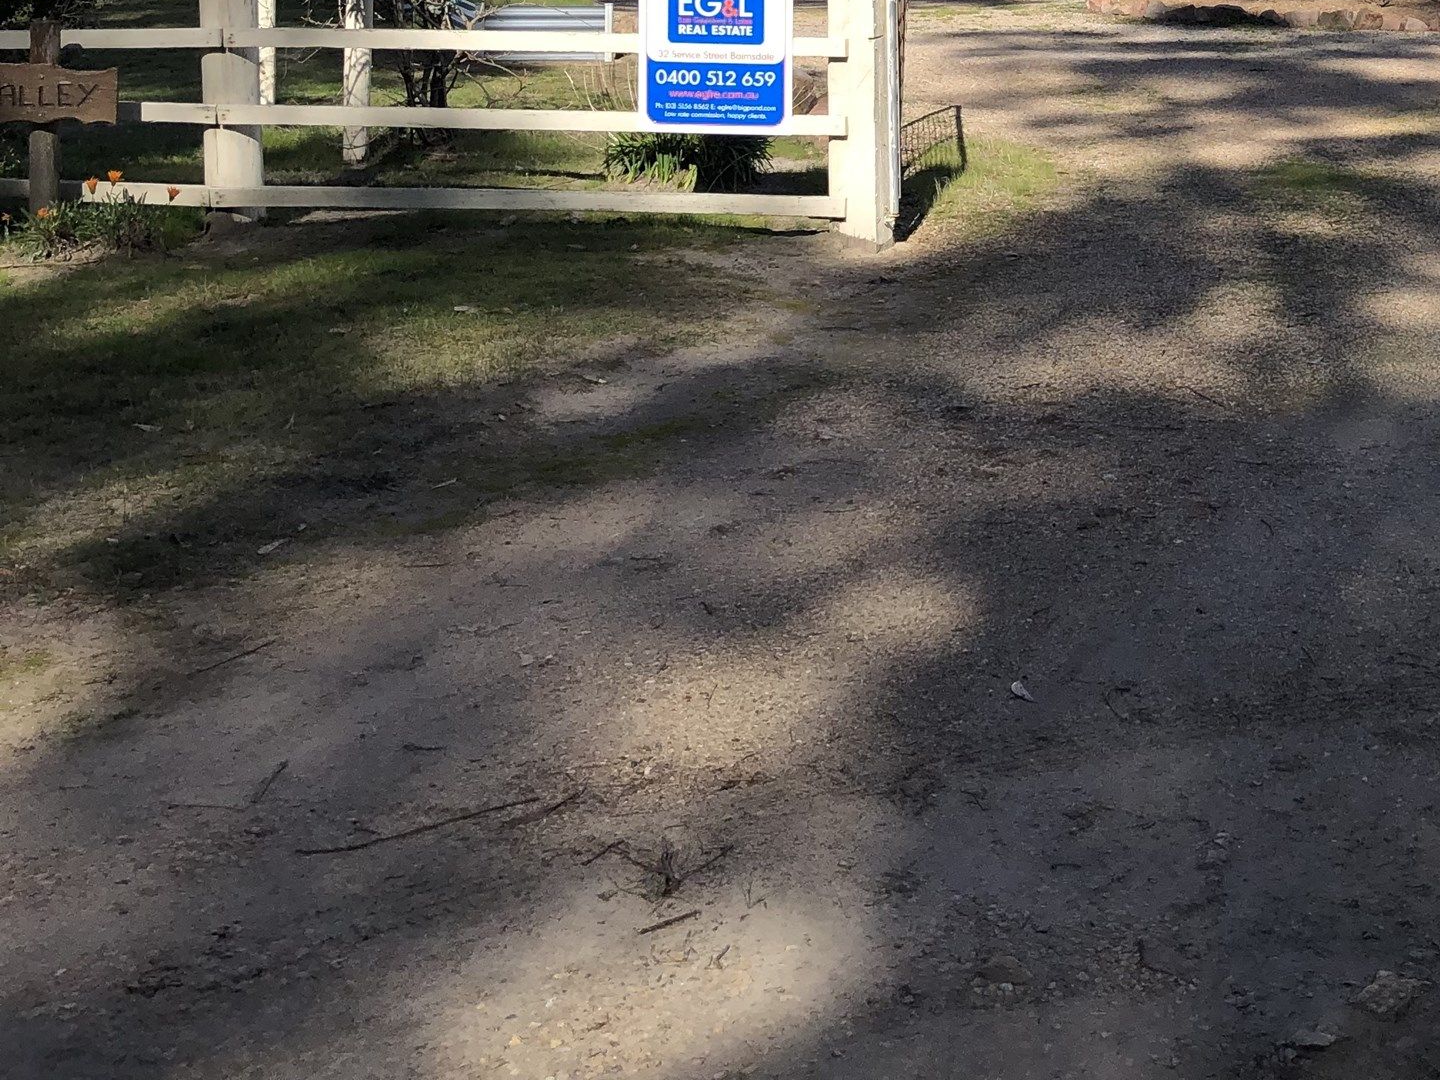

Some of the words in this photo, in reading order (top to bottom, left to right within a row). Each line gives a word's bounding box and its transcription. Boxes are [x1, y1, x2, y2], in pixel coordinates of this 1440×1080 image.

[678, 23, 708, 35] REAL
[711, 25, 754, 37] ESTATE
[658, 49, 670, 59] 32
[672, 50, 701, 60] Service
[703, 50, 728, 60] Street
[655, 68, 701, 86] 0400
[705, 70, 737, 86] 512
[741, 71, 776, 87] 659
